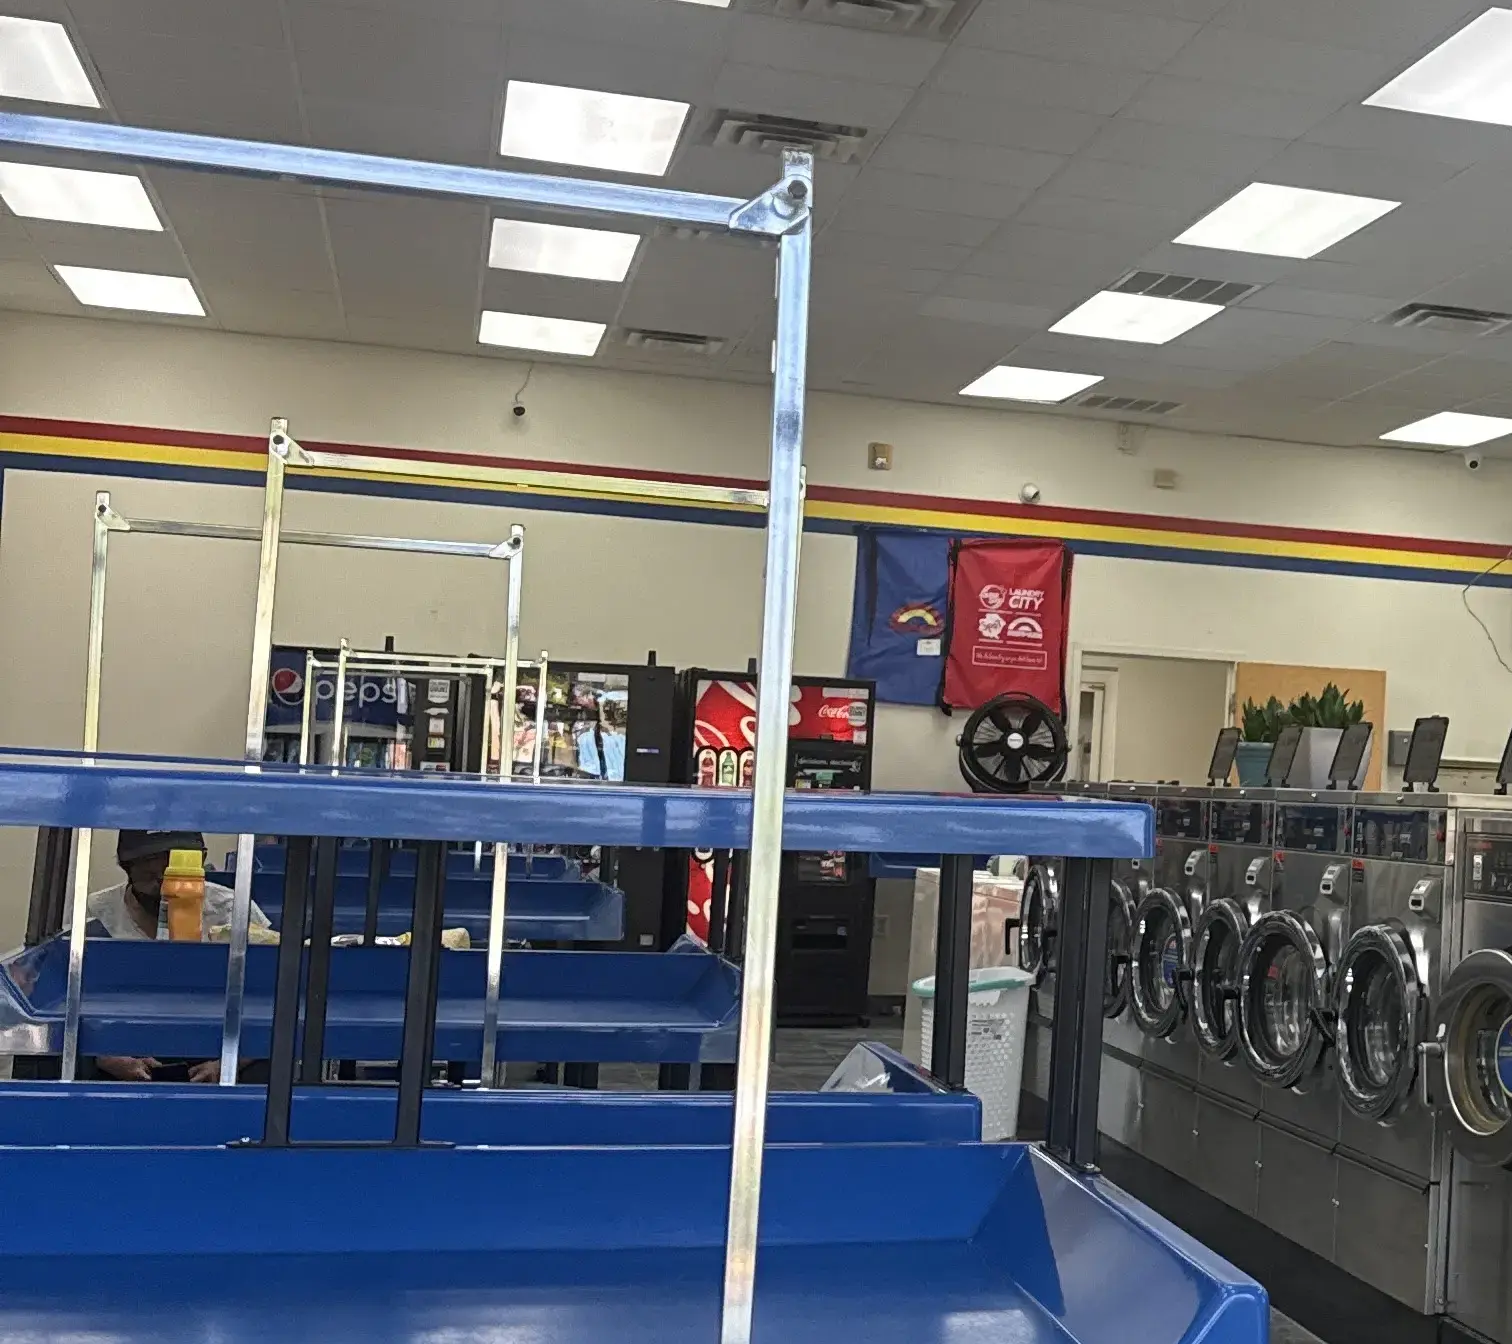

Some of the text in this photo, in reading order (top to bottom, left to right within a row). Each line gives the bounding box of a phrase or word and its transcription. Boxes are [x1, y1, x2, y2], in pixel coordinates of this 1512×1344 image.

[1009, 588, 1044, 597] LAUNDRY
[1008, 596, 1044, 611] CITY
[315, 677, 404, 708] peps
